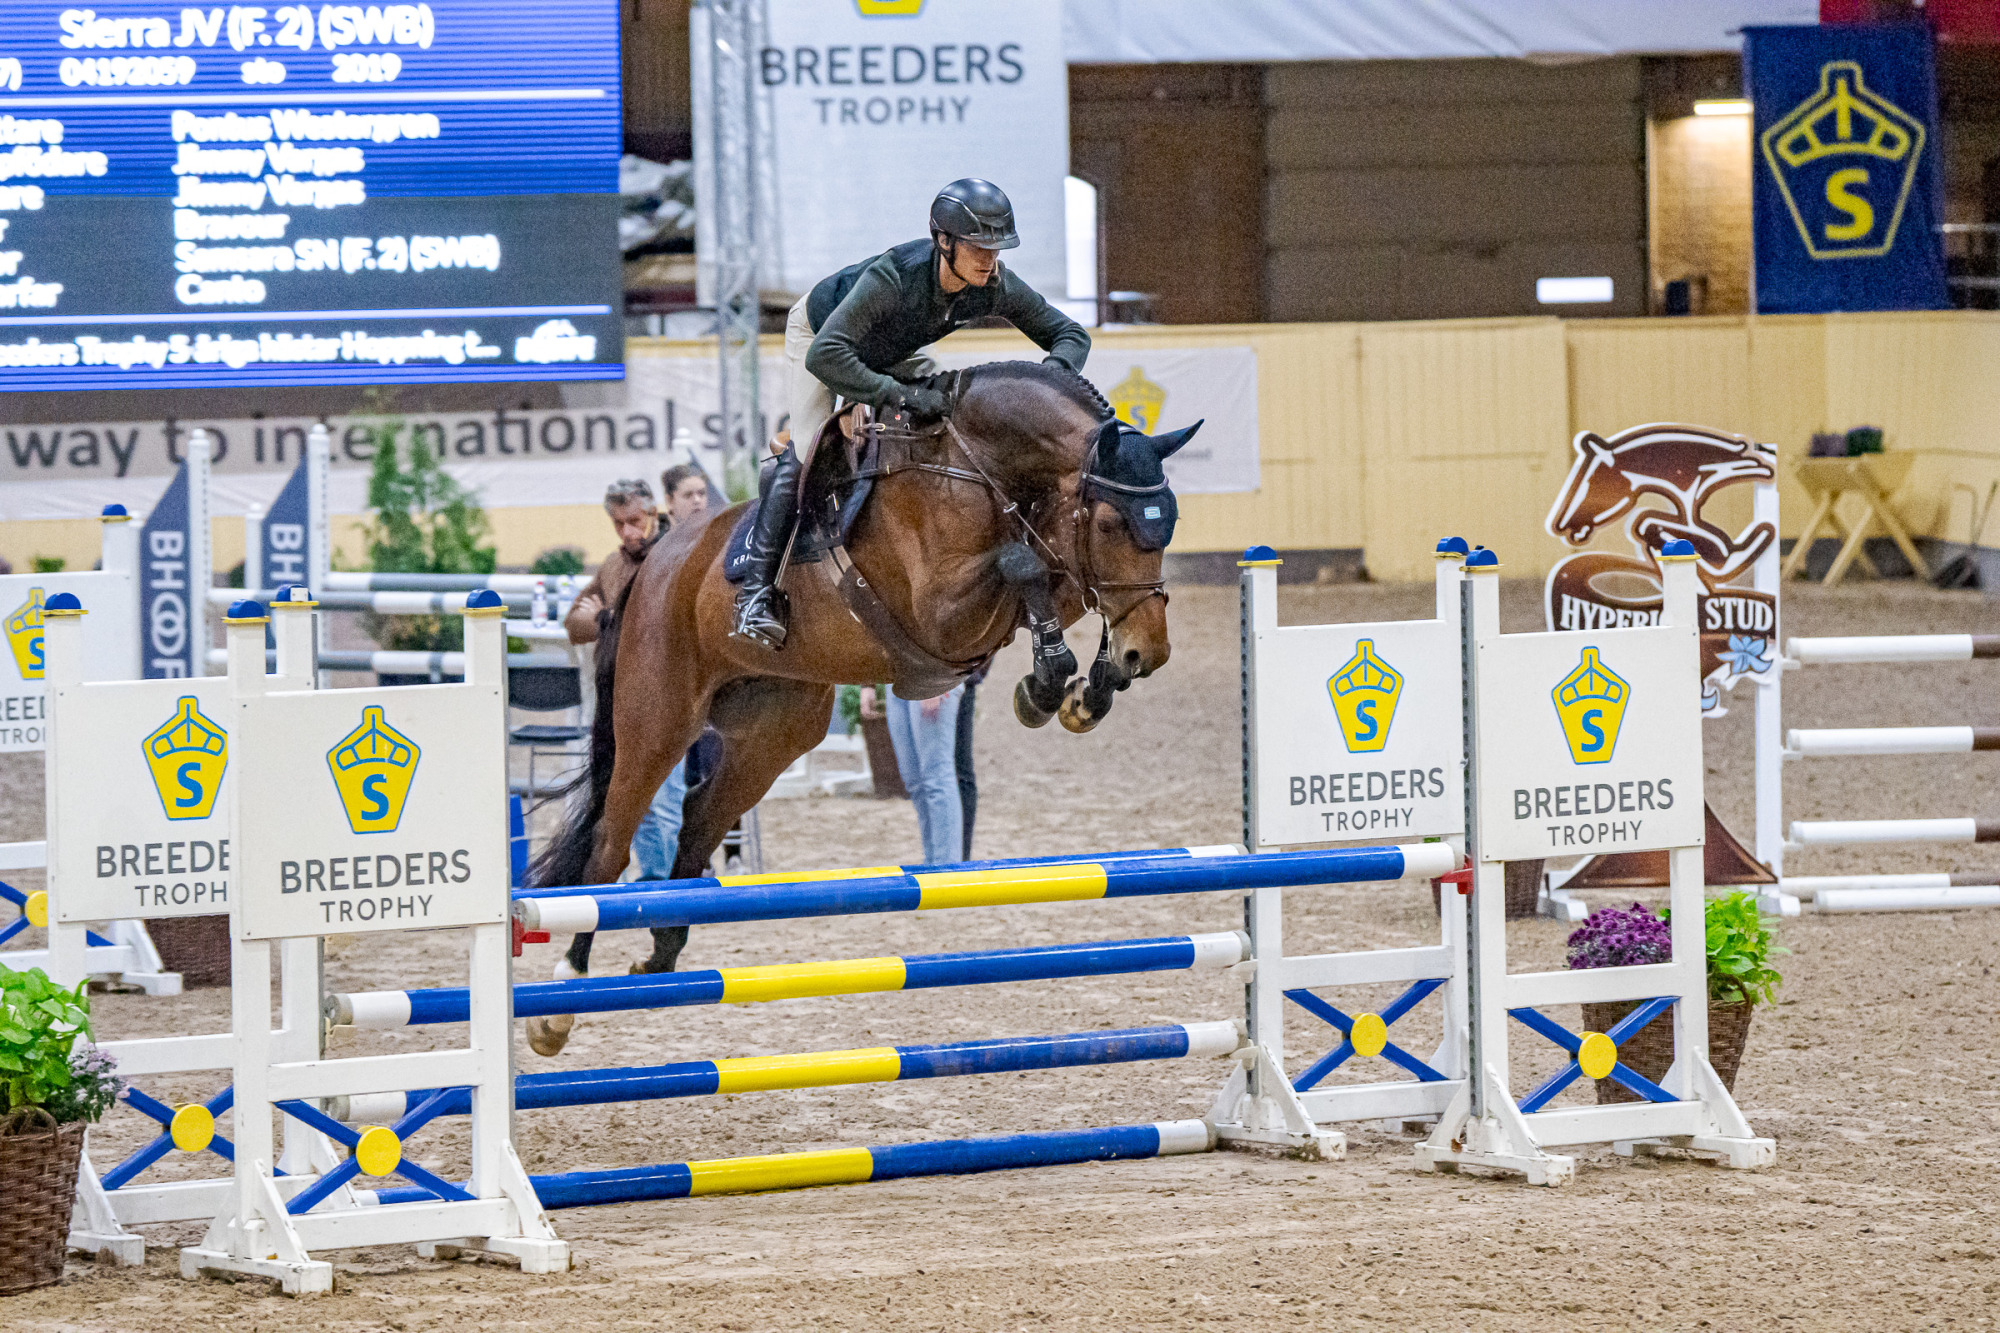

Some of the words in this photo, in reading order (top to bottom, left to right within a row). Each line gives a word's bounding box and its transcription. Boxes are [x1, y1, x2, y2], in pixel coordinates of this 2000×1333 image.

[59, 8, 171, 49] Sierra
[172, 7, 225, 47] JV
[318, 3, 435, 50] (SWB)
[331, 52, 402, 83] 2019
[759, 43, 1025, 86] BREEDERS
[813, 95, 973, 126] TROPHY
[6, 425, 139, 478] way
[162, 414, 228, 465] to
[252, 400, 676, 464] inenational
[1705, 597, 1774, 632] STUD
[1289, 767, 1445, 806] BREEDERS
[1514, 778, 1674, 820] BREEDERS
[1321, 807, 1414, 832] TROPHY
[1547, 820, 1643, 847] TROPHY
[281, 849, 472, 894] BREEDERS
[320, 895, 434, 924] TROPHY
